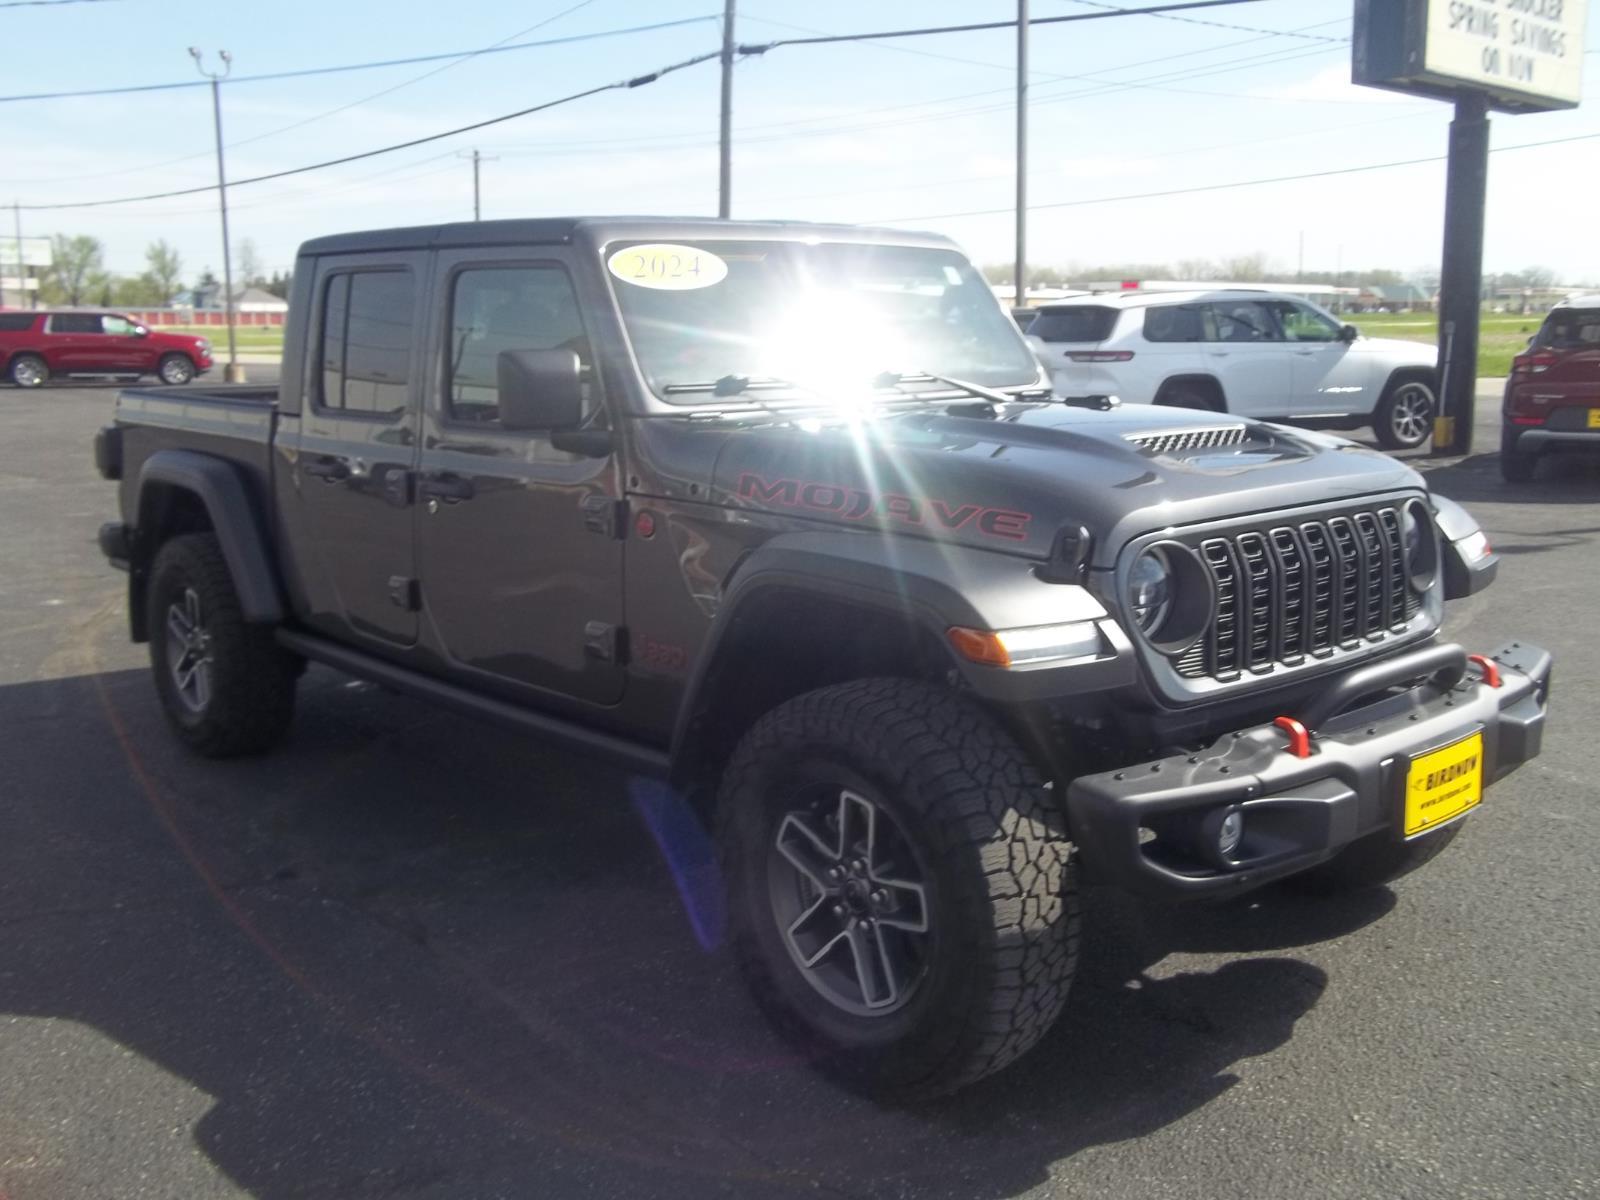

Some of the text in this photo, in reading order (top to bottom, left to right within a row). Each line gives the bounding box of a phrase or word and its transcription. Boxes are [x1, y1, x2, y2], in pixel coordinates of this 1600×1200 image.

[1449, 1, 1567, 57] SPRING SAVINGS
[1481, 46, 1534, 81] ON NOW
[635, 255, 700, 278] 2024
[739, 472, 1031, 541] MOJAVE
[1426, 755, 1477, 791] BIRDNOW
